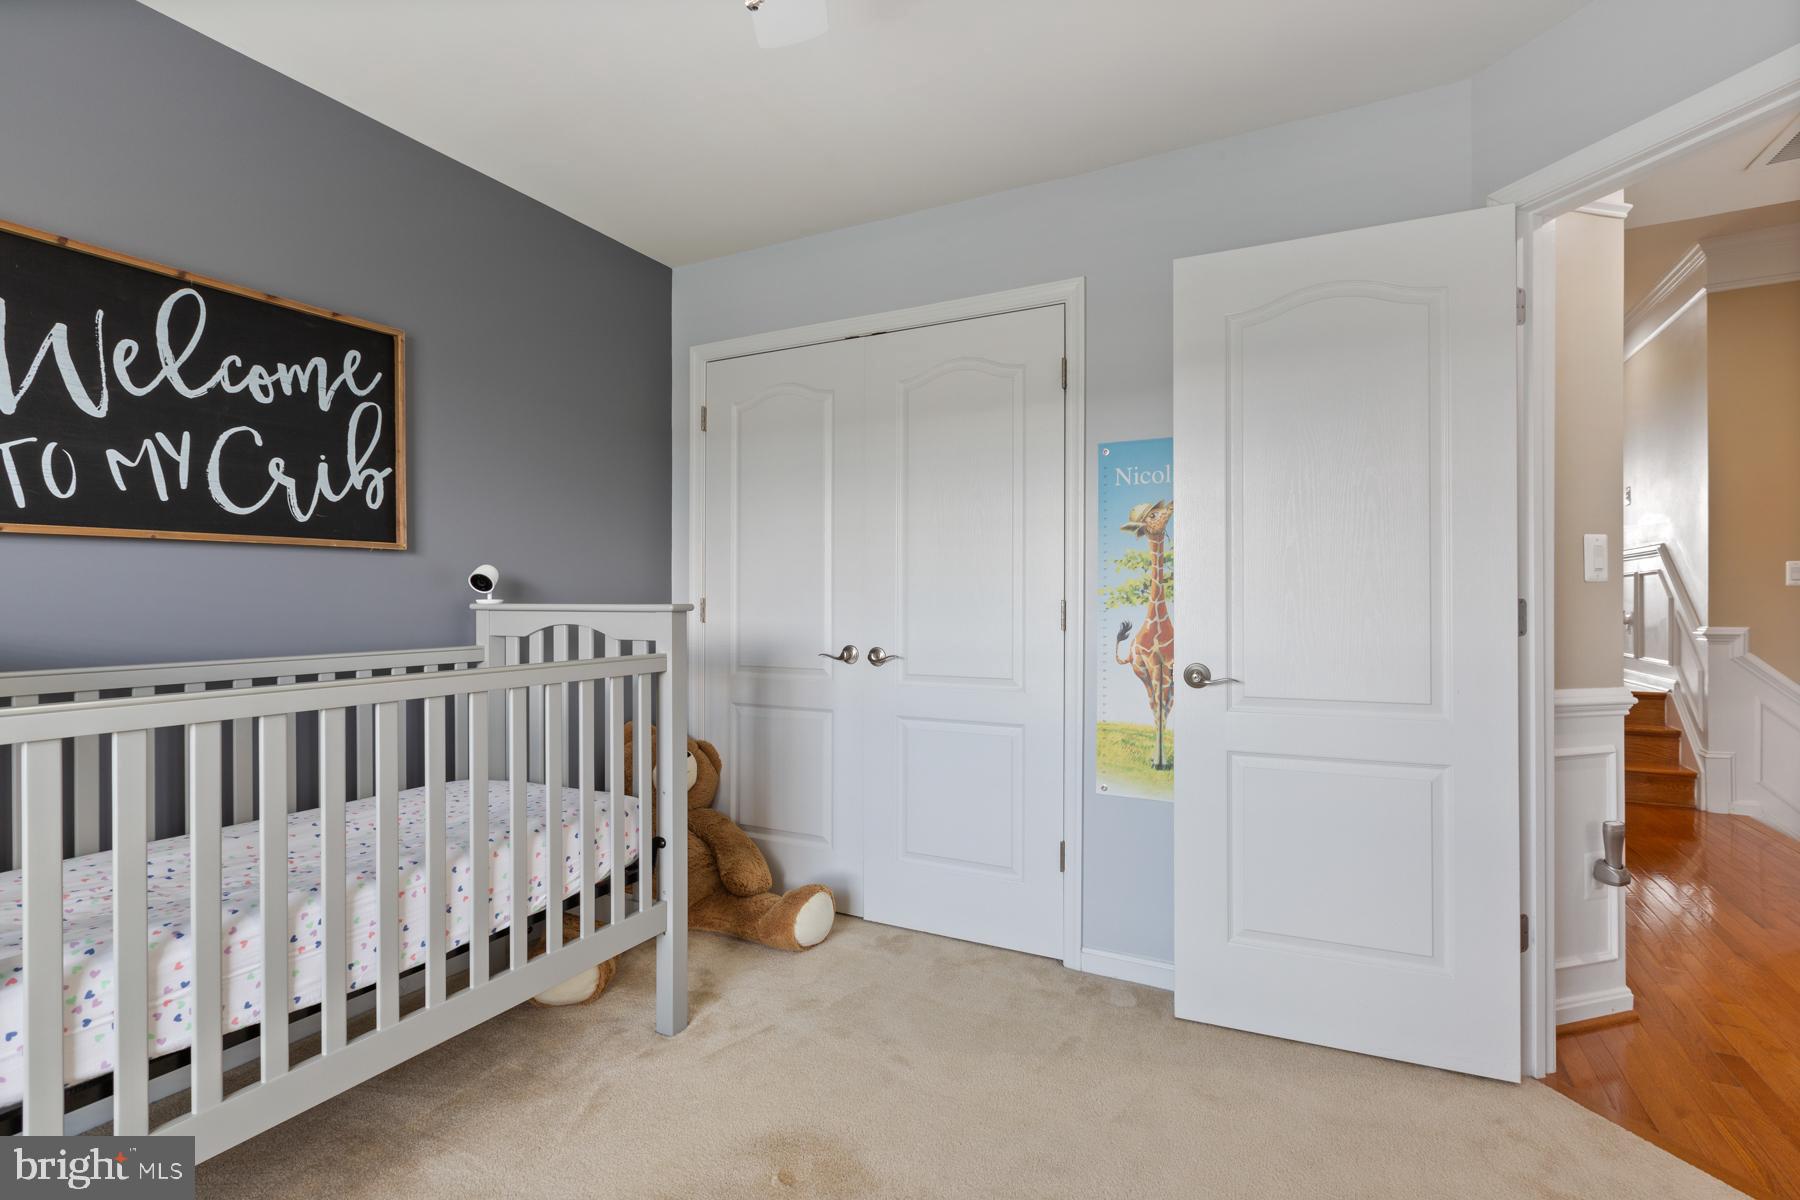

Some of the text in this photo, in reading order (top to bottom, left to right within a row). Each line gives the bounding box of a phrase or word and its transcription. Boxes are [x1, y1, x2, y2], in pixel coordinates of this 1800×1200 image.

[0, 288, 382, 418] Welcome
[0, 401, 392, 522] TO MY Crib
